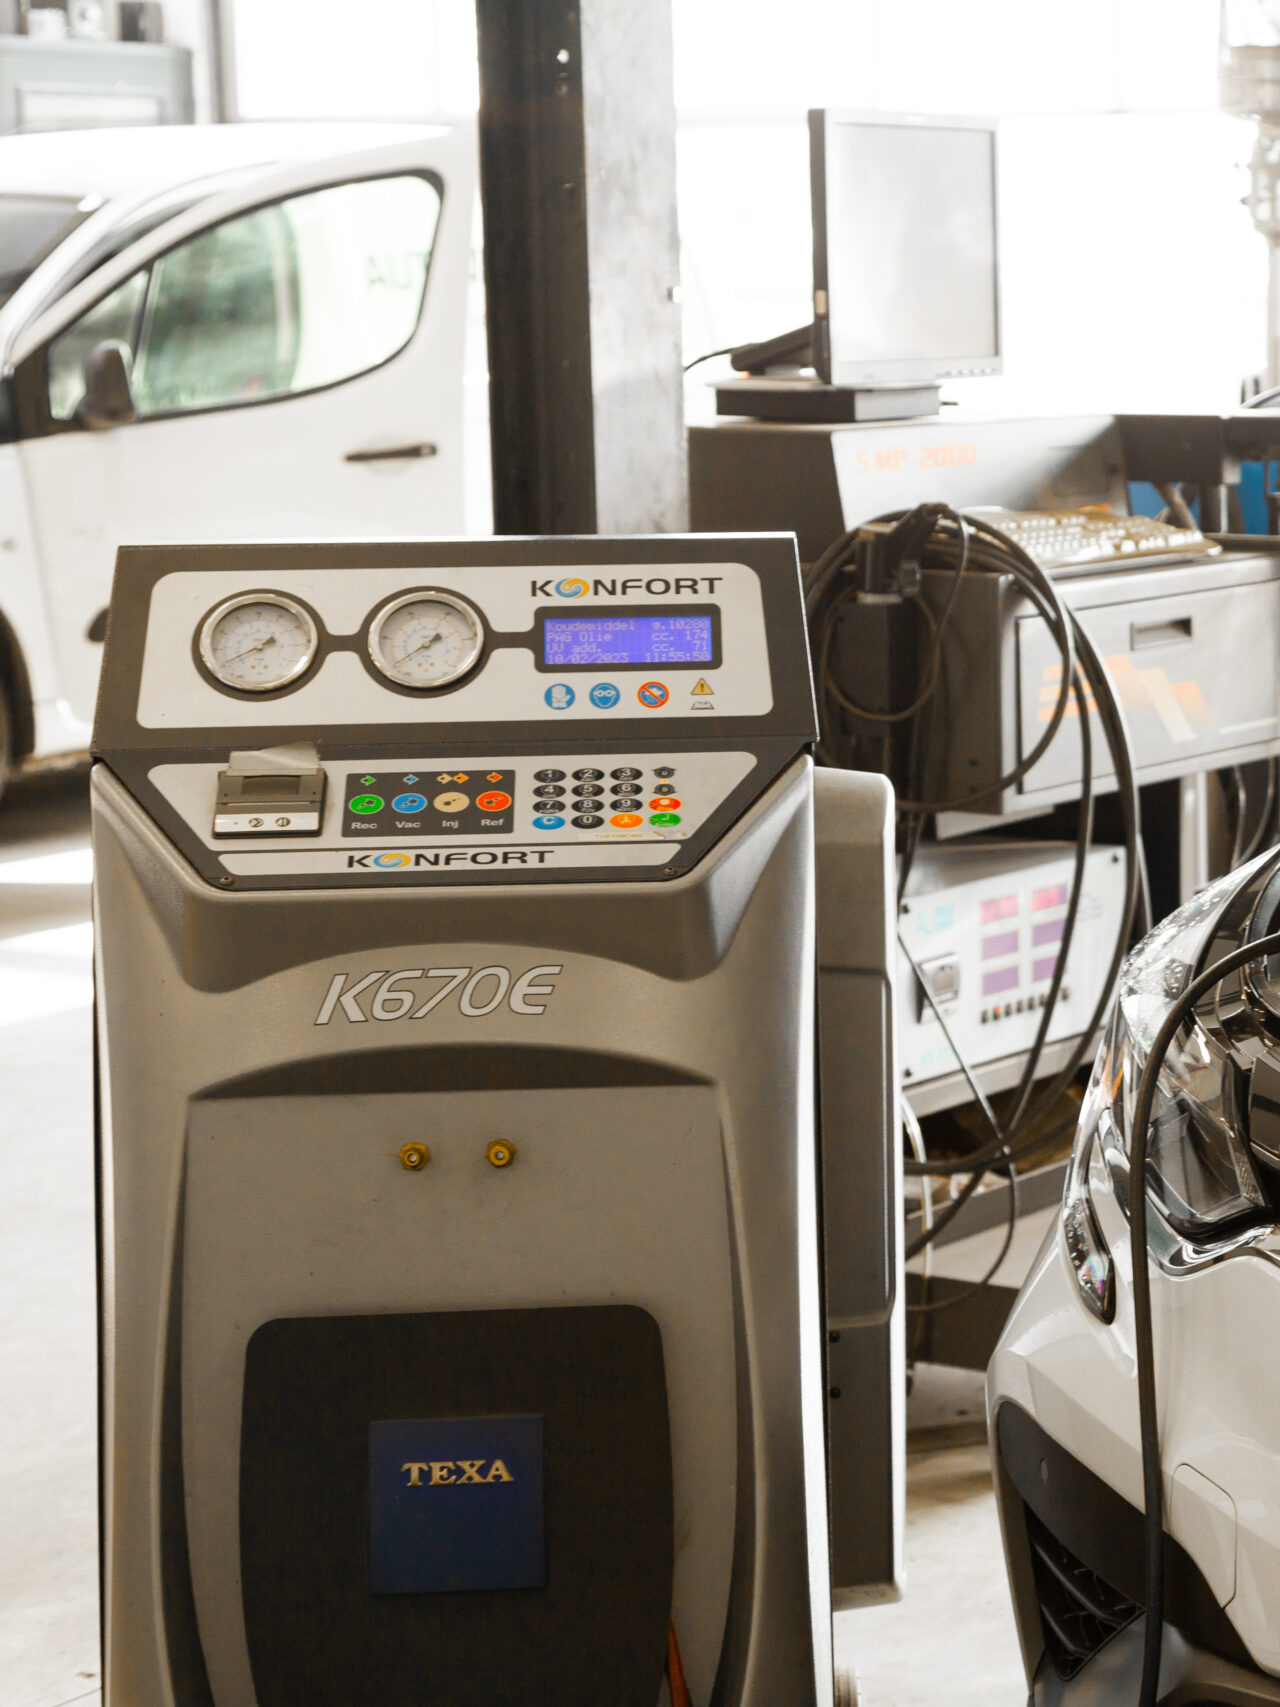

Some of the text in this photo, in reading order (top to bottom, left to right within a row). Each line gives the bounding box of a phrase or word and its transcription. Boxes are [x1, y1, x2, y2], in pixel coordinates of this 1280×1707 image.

[919, 443, 978, 471] 2000
[531, 577, 723, 598] KONFORT
[547, 620, 635, 632] Koudemiddel
[547, 632, 571, 642] PAG
[579, 631, 613, 642] Olie
[685, 629, 708, 641] 174
[572, 643, 602, 653] add.
[693, 640, 708, 651] 71
[549, 652, 628, 664] 10/02/2023
[351, 821, 378, 830] Rec
[395, 820, 421, 829] Vac
[441, 819, 459, 829] Inj
[480, 818, 505, 827] Ref
[347, 850, 554, 868] KONFORT
[313, 964, 564, 1025] K670E
[400, 1459, 515, 1487] TEXA
